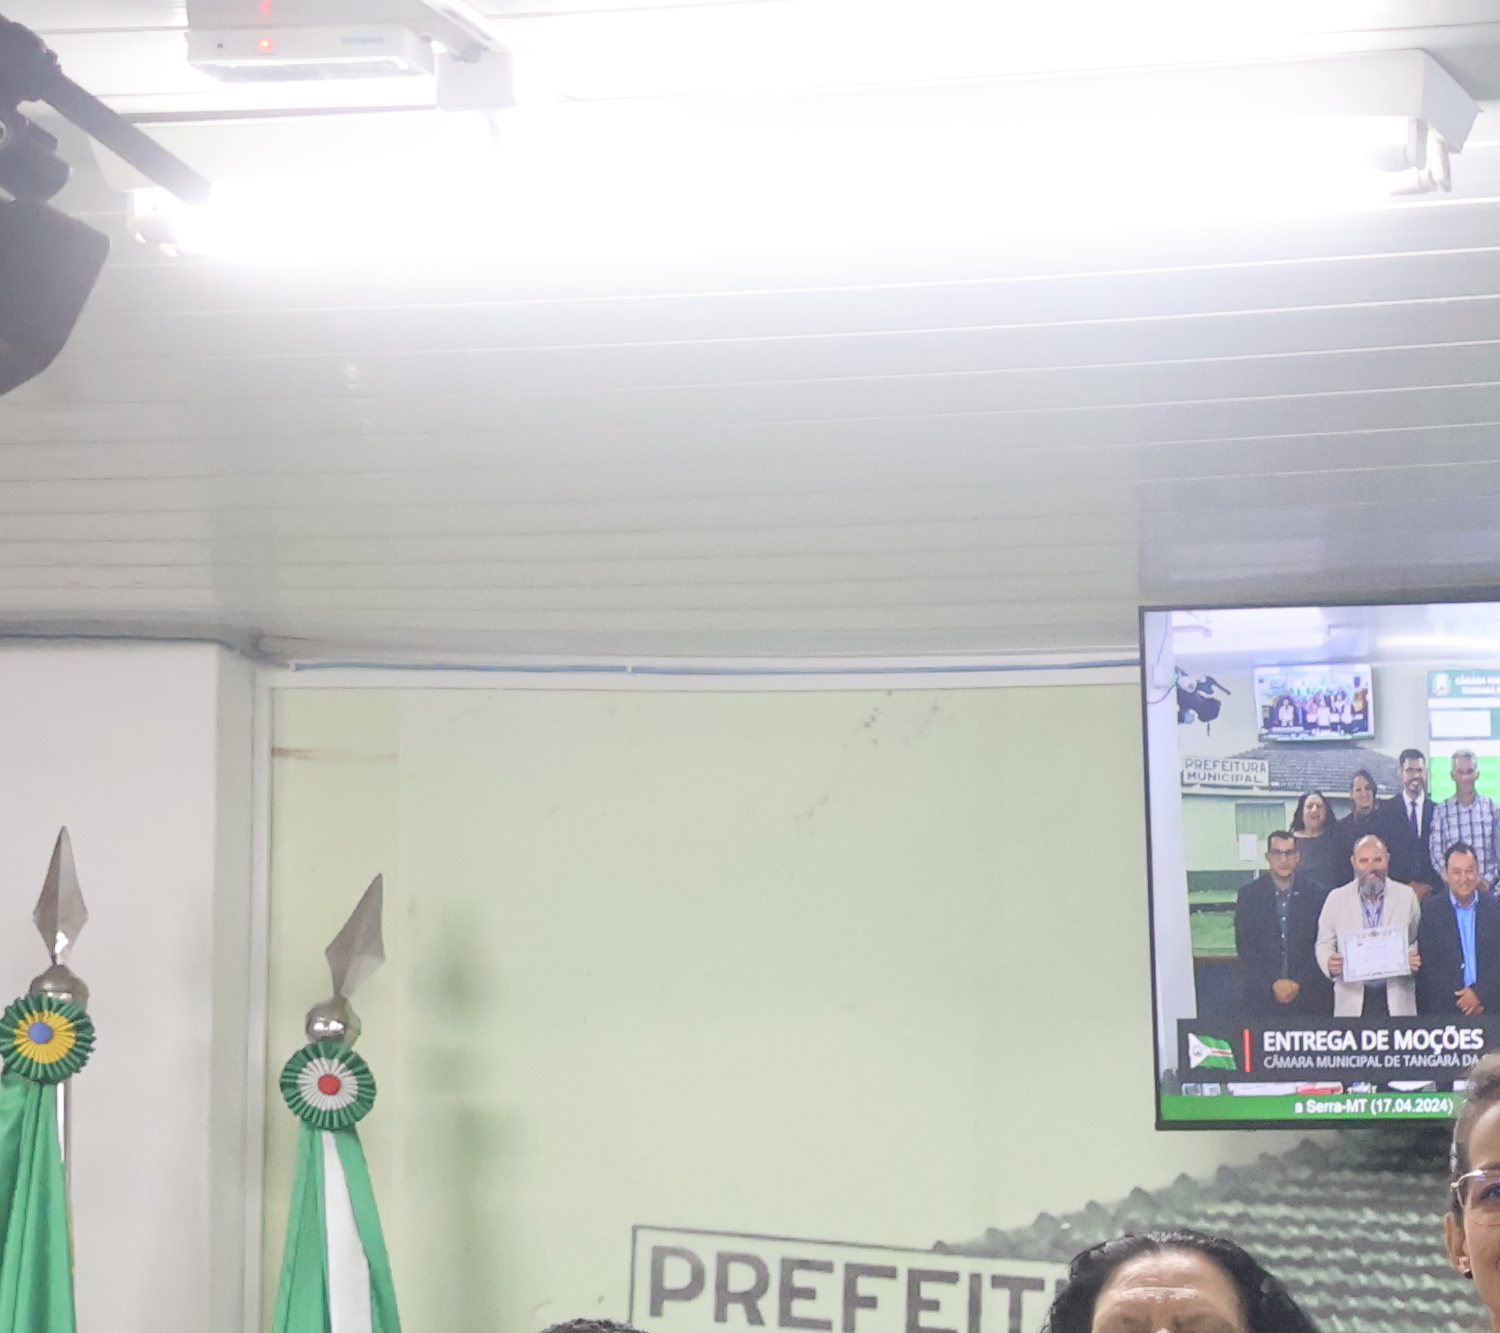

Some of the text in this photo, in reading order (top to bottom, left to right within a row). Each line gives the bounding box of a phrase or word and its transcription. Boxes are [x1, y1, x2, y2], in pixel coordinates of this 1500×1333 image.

[1185, 758, 1266, 773] PREFEITURA
[1187, 771, 1263, 783] MUNICIPAL
[1263, 1025, 1484, 1054] ENTREGA DE MOÇÕES
[1264, 1053, 1313, 1069] CÂMARA
[1316, 1055, 1382, 1068] MUNICIPAL
[1385, 1055, 1401, 1068] DE
[1403, 1052, 1460, 1068] TANGARÁ
[1306, 1099, 1367, 1114] Serra-MT
[1371, 1098, 1454, 1115] (17.04.2024)
